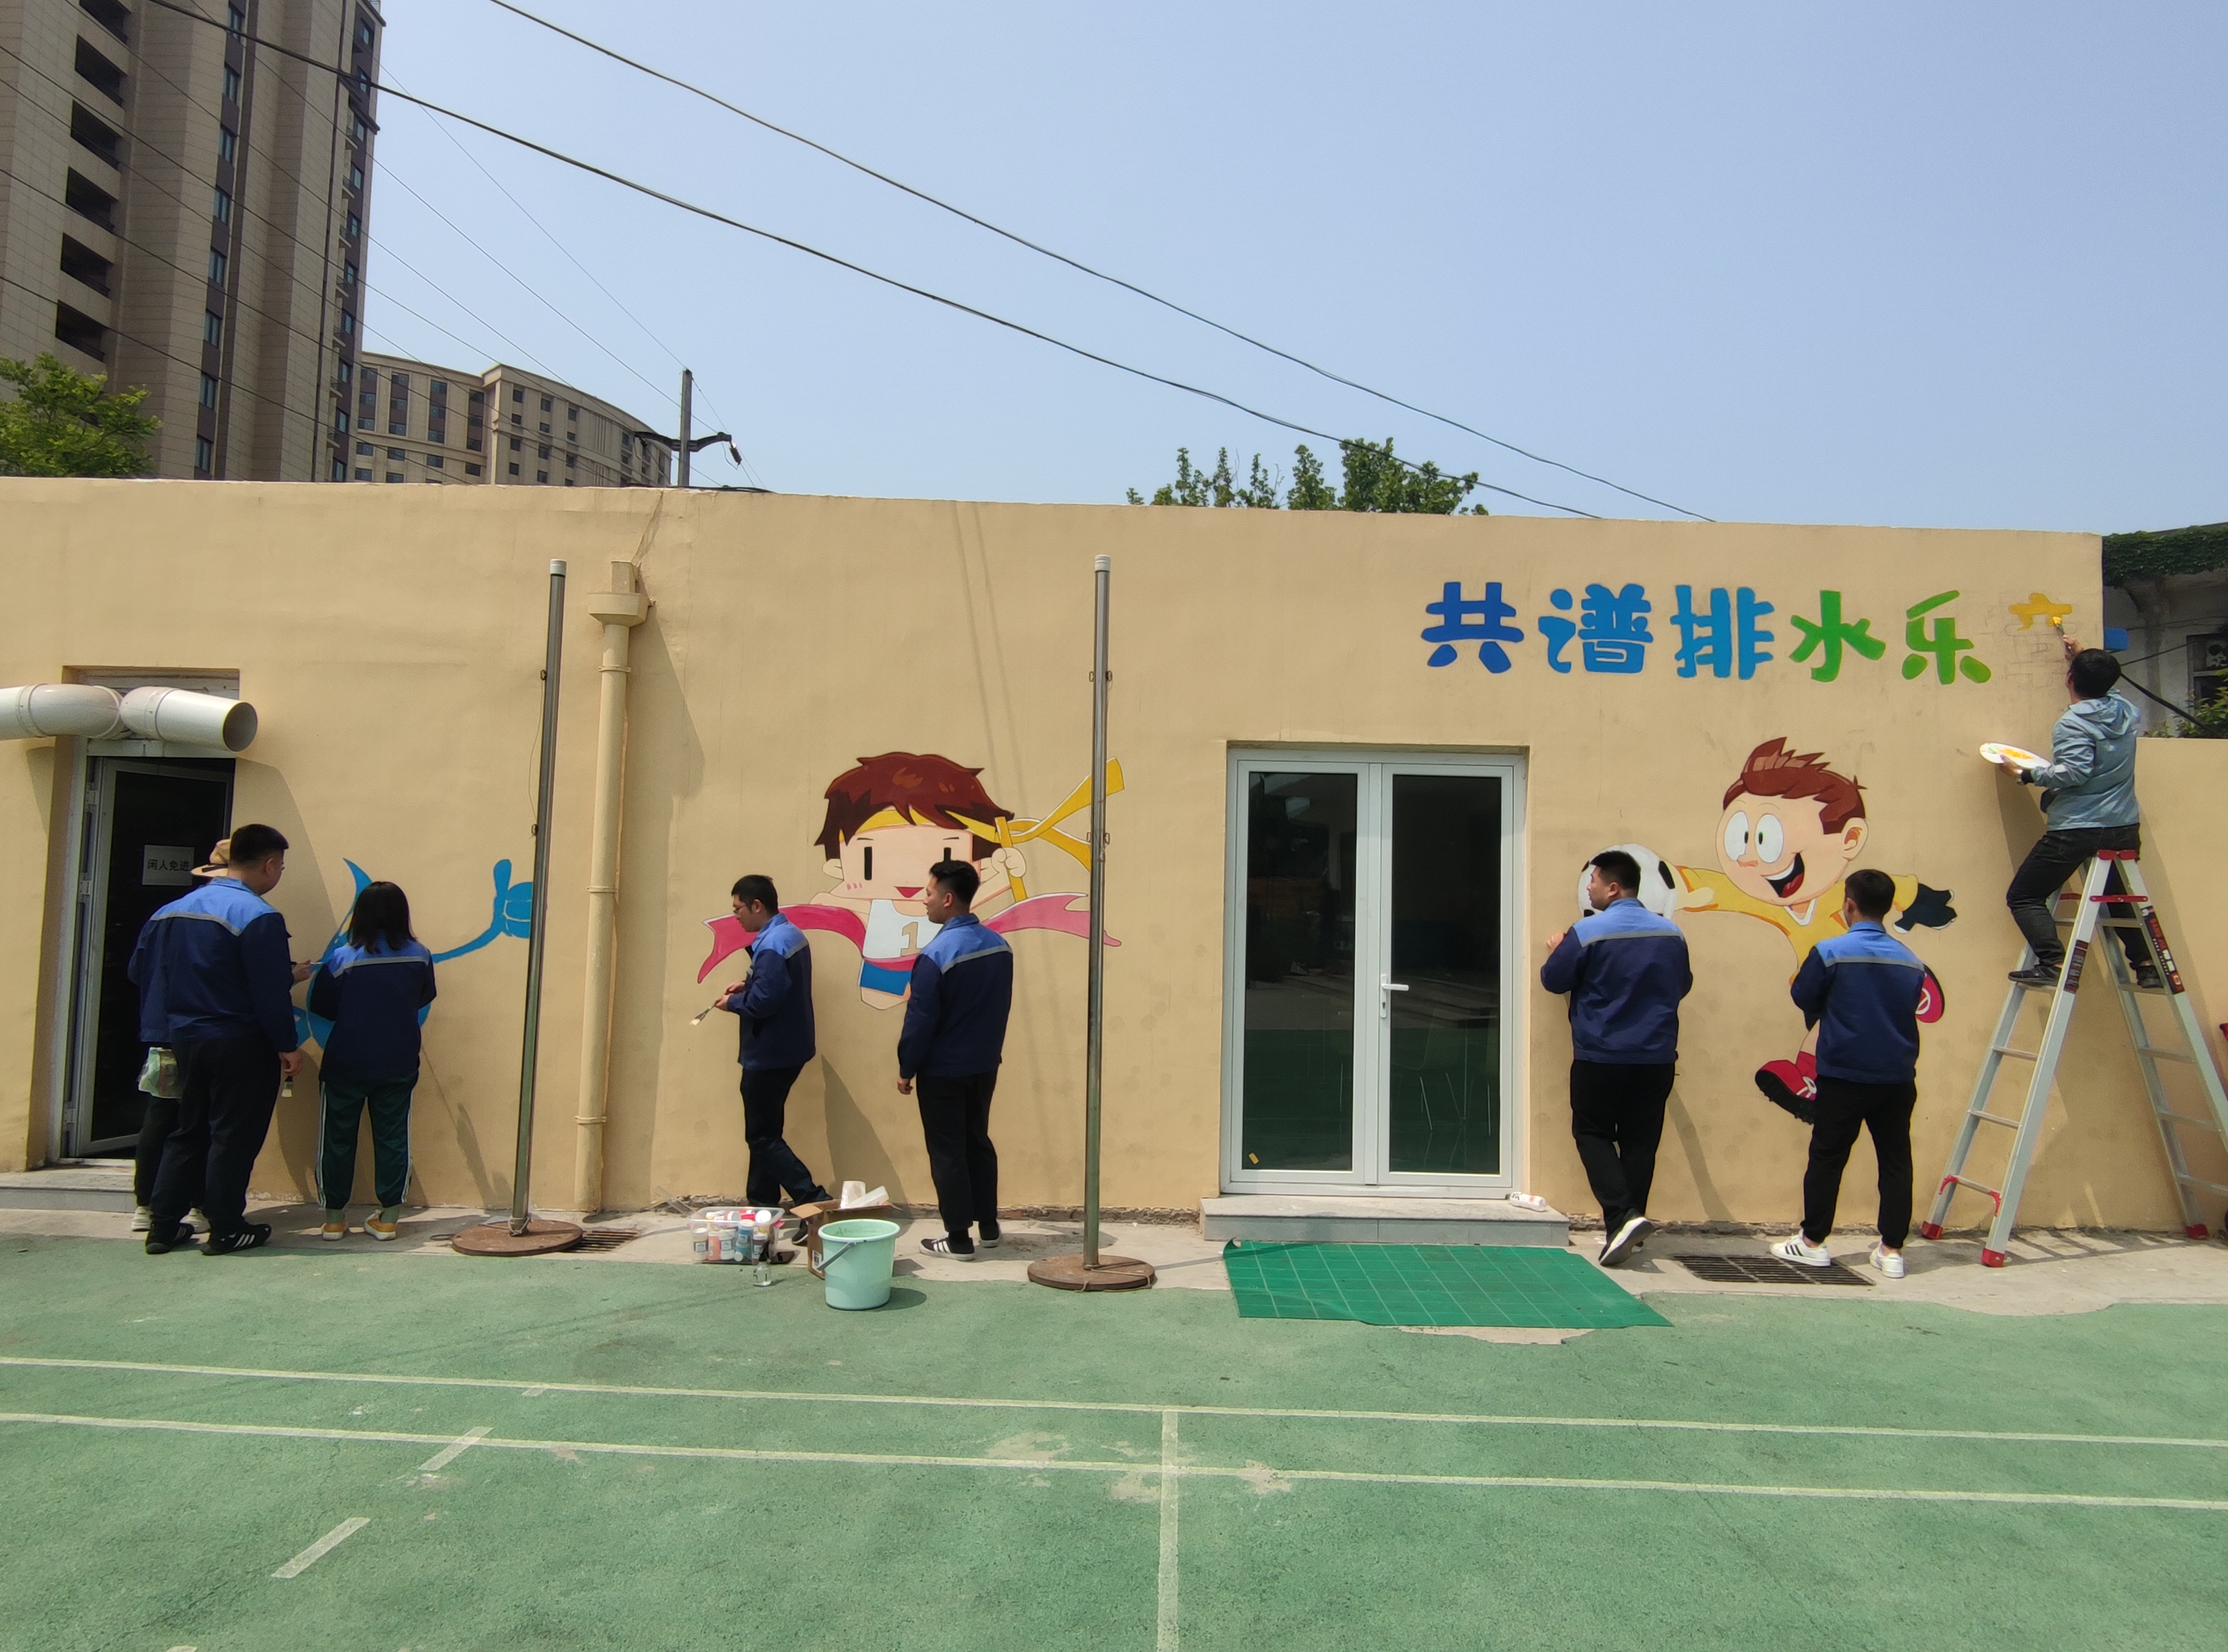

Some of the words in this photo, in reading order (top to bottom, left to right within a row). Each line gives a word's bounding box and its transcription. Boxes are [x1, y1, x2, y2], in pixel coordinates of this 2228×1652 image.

[147, 859, 190, 872] 闲人免进
[901, 922, 923, 955] 1
